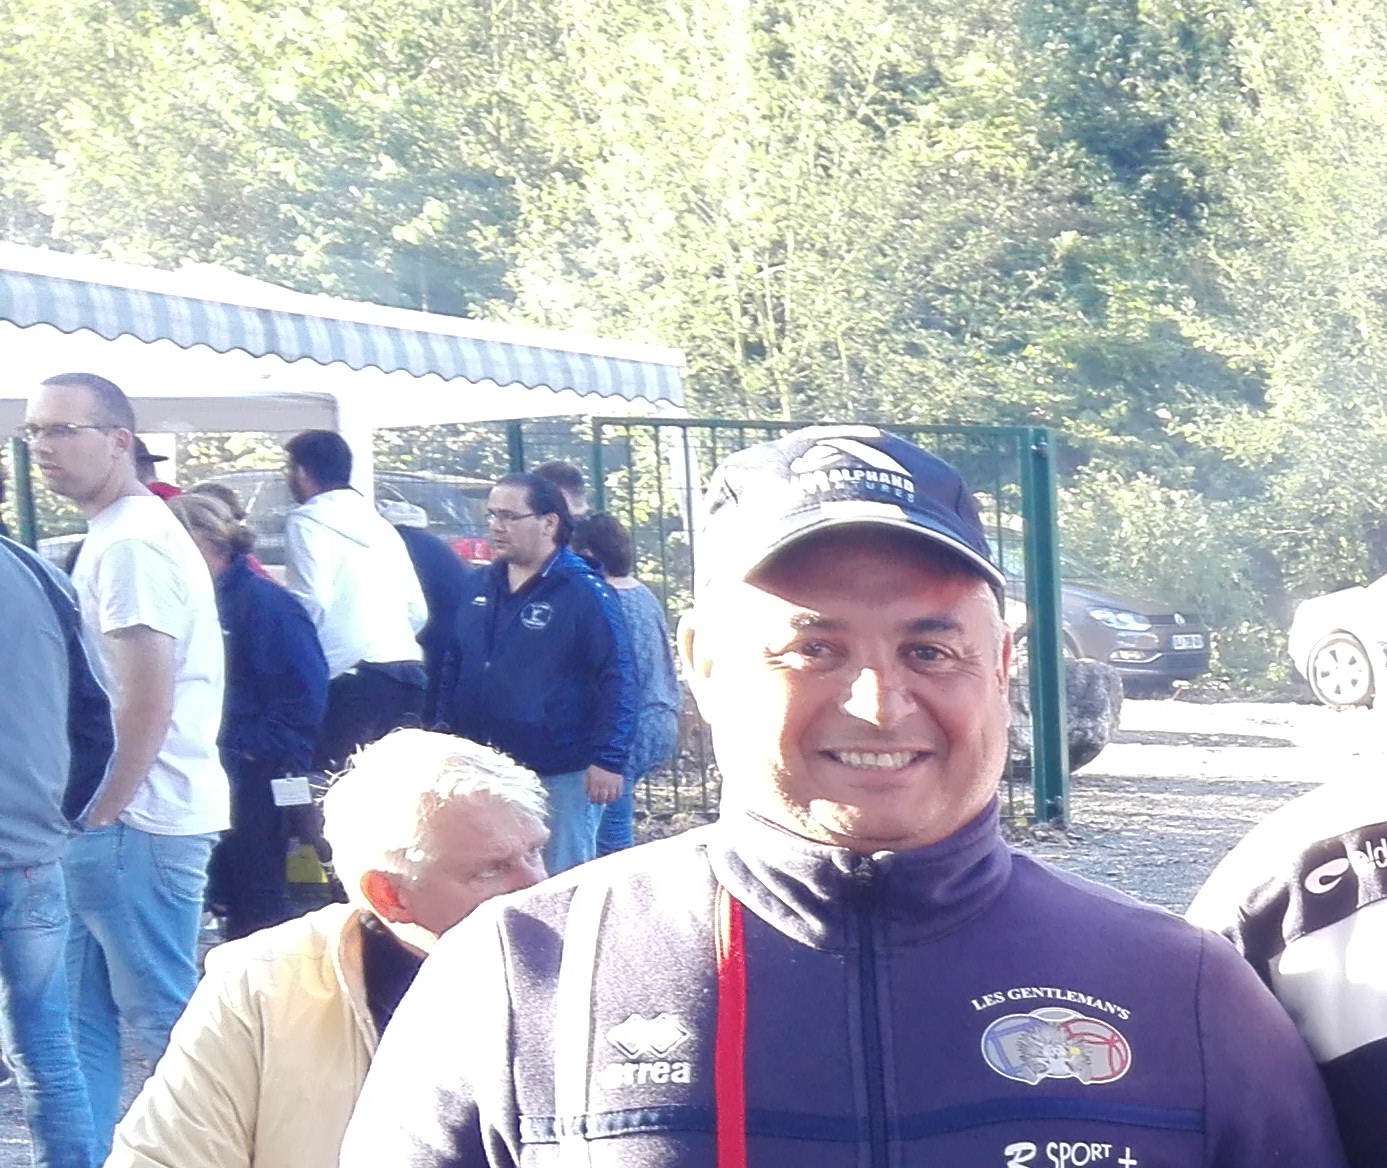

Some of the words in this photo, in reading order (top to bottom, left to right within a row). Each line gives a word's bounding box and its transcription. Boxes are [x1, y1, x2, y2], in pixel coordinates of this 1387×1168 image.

[971, 991, 1006, 1011] LES
[1007, 987, 1131, 1020] GENTLEMAN'S
[601, 1061, 691, 1089] rrea
